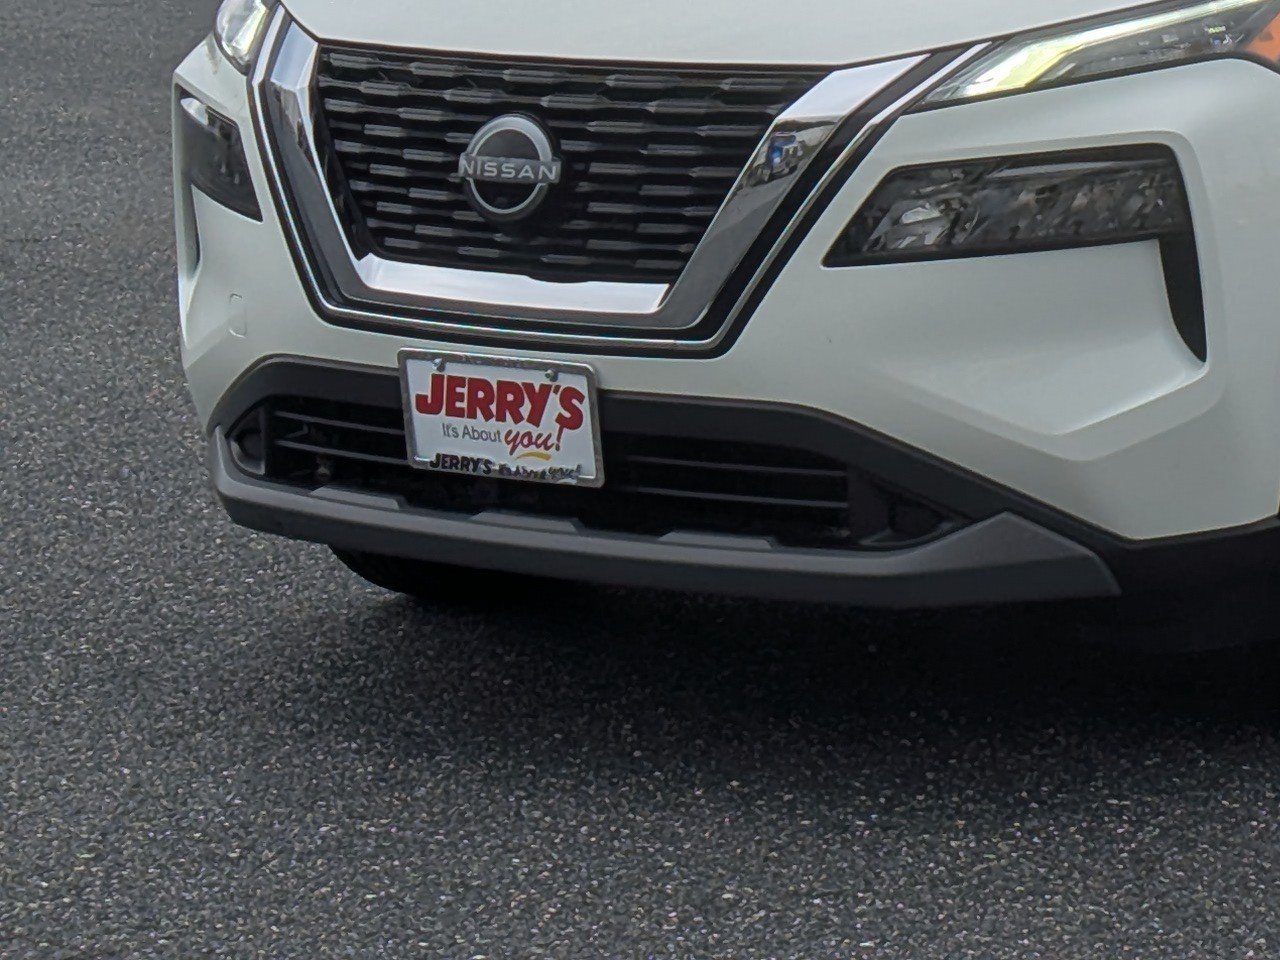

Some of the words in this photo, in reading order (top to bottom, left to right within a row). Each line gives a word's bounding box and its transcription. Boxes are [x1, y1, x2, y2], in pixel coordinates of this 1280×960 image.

[460, 156, 557, 181] NISSAN
[414, 372, 586, 431] JERRY'S
[442, 421, 460, 439] It's
[462, 425, 502, 443] About
[503, 426, 565, 456] you!
[429, 452, 493, 475] JERRY'S
